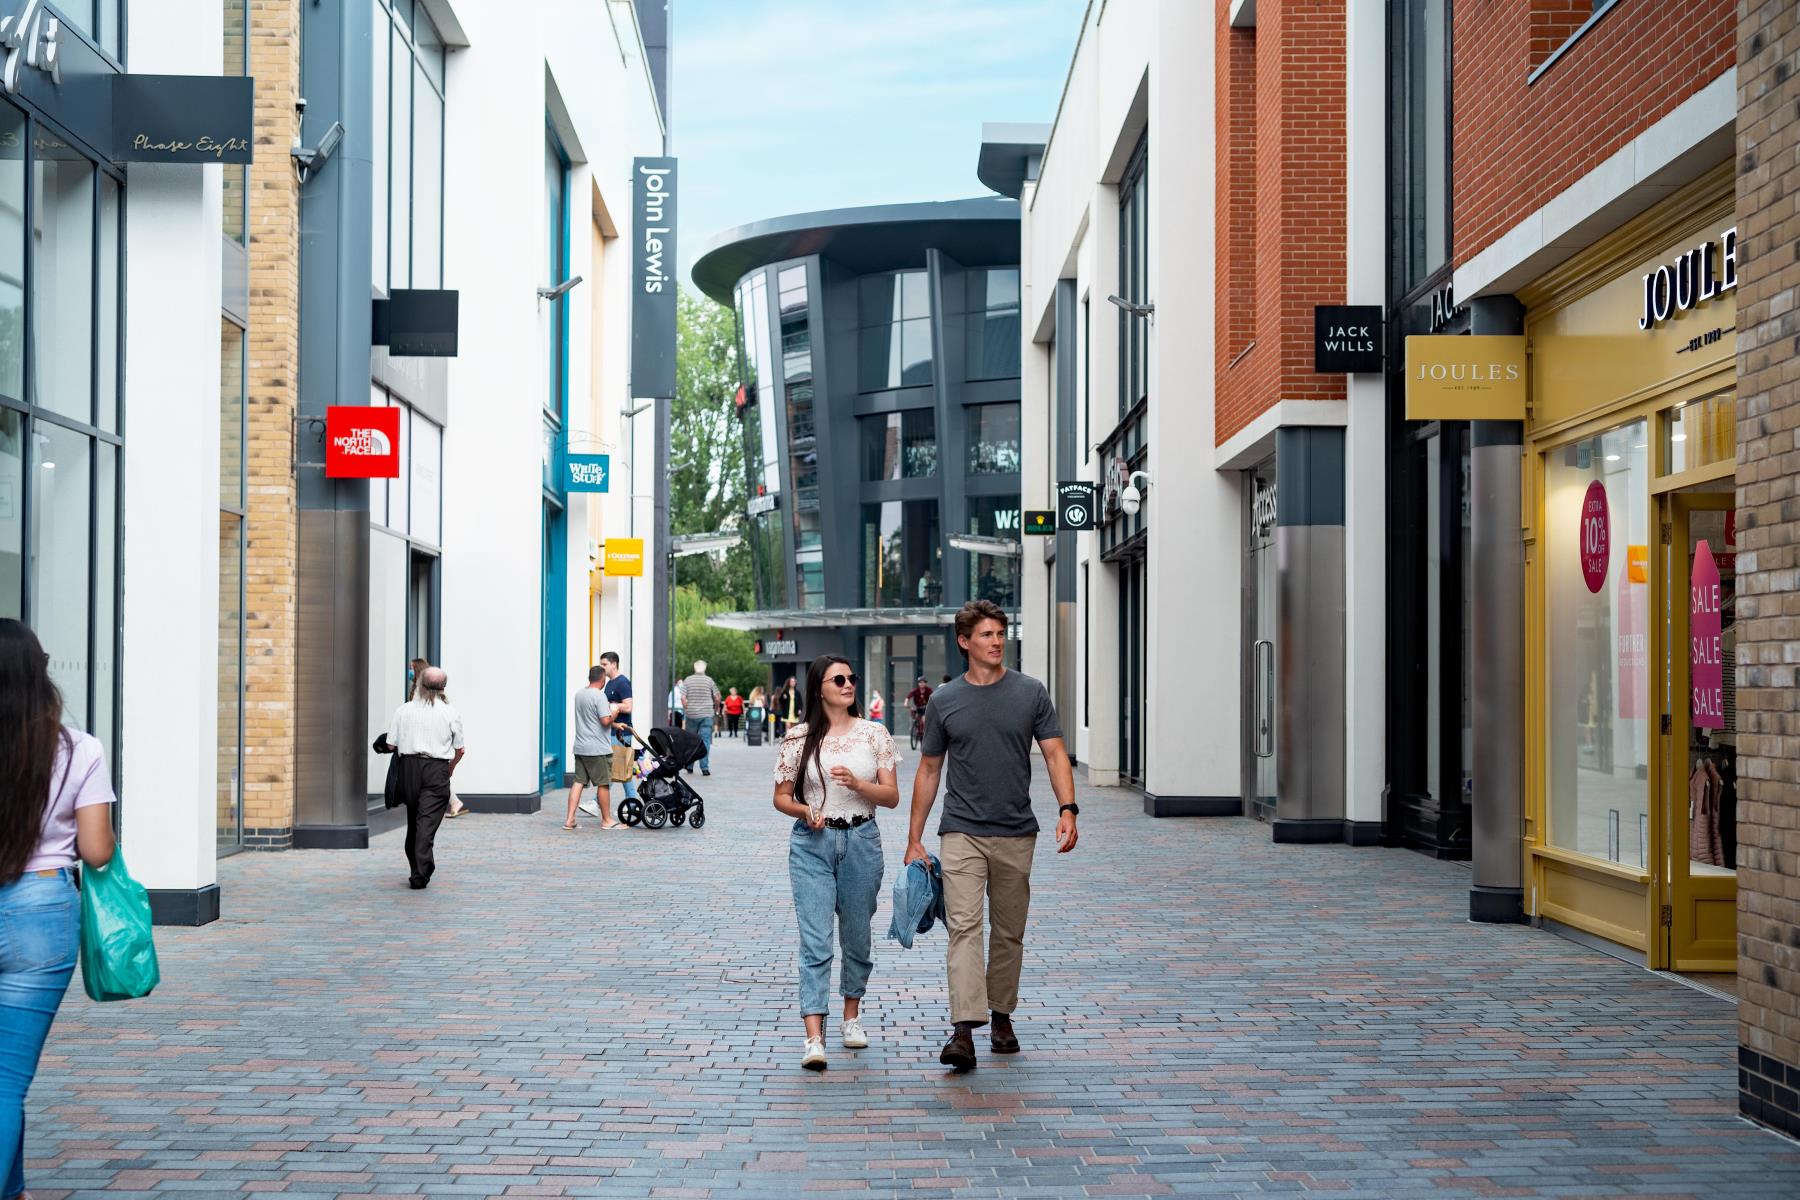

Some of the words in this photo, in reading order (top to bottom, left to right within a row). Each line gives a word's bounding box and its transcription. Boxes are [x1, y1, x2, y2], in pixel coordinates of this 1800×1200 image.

[134, 134, 193, 153] Phase
[195, 136, 249, 158] Eight
[640, 165, 671, 221] John
[645, 227, 671, 293] Lewis
[1430, 282, 1464, 333] JAC
[1329, 326, 1369, 338] JACK
[1324, 341, 1374, 352] WILLS
[1416, 364, 1520, 380] JOULES
[350, 428, 371, 438] THE
[334, 437, 371, 447] NORTH
[344, 446, 371, 455] FACE
[1060, 484, 1092, 494] FATFACE
[1588, 501, 1602, 512] EXTRA
[1588, 559, 1602, 573] SALE
[1692, 584, 1719, 614] SALE
[1693, 636, 1720, 664] SALE
[1694, 687, 1722, 716] SALE
